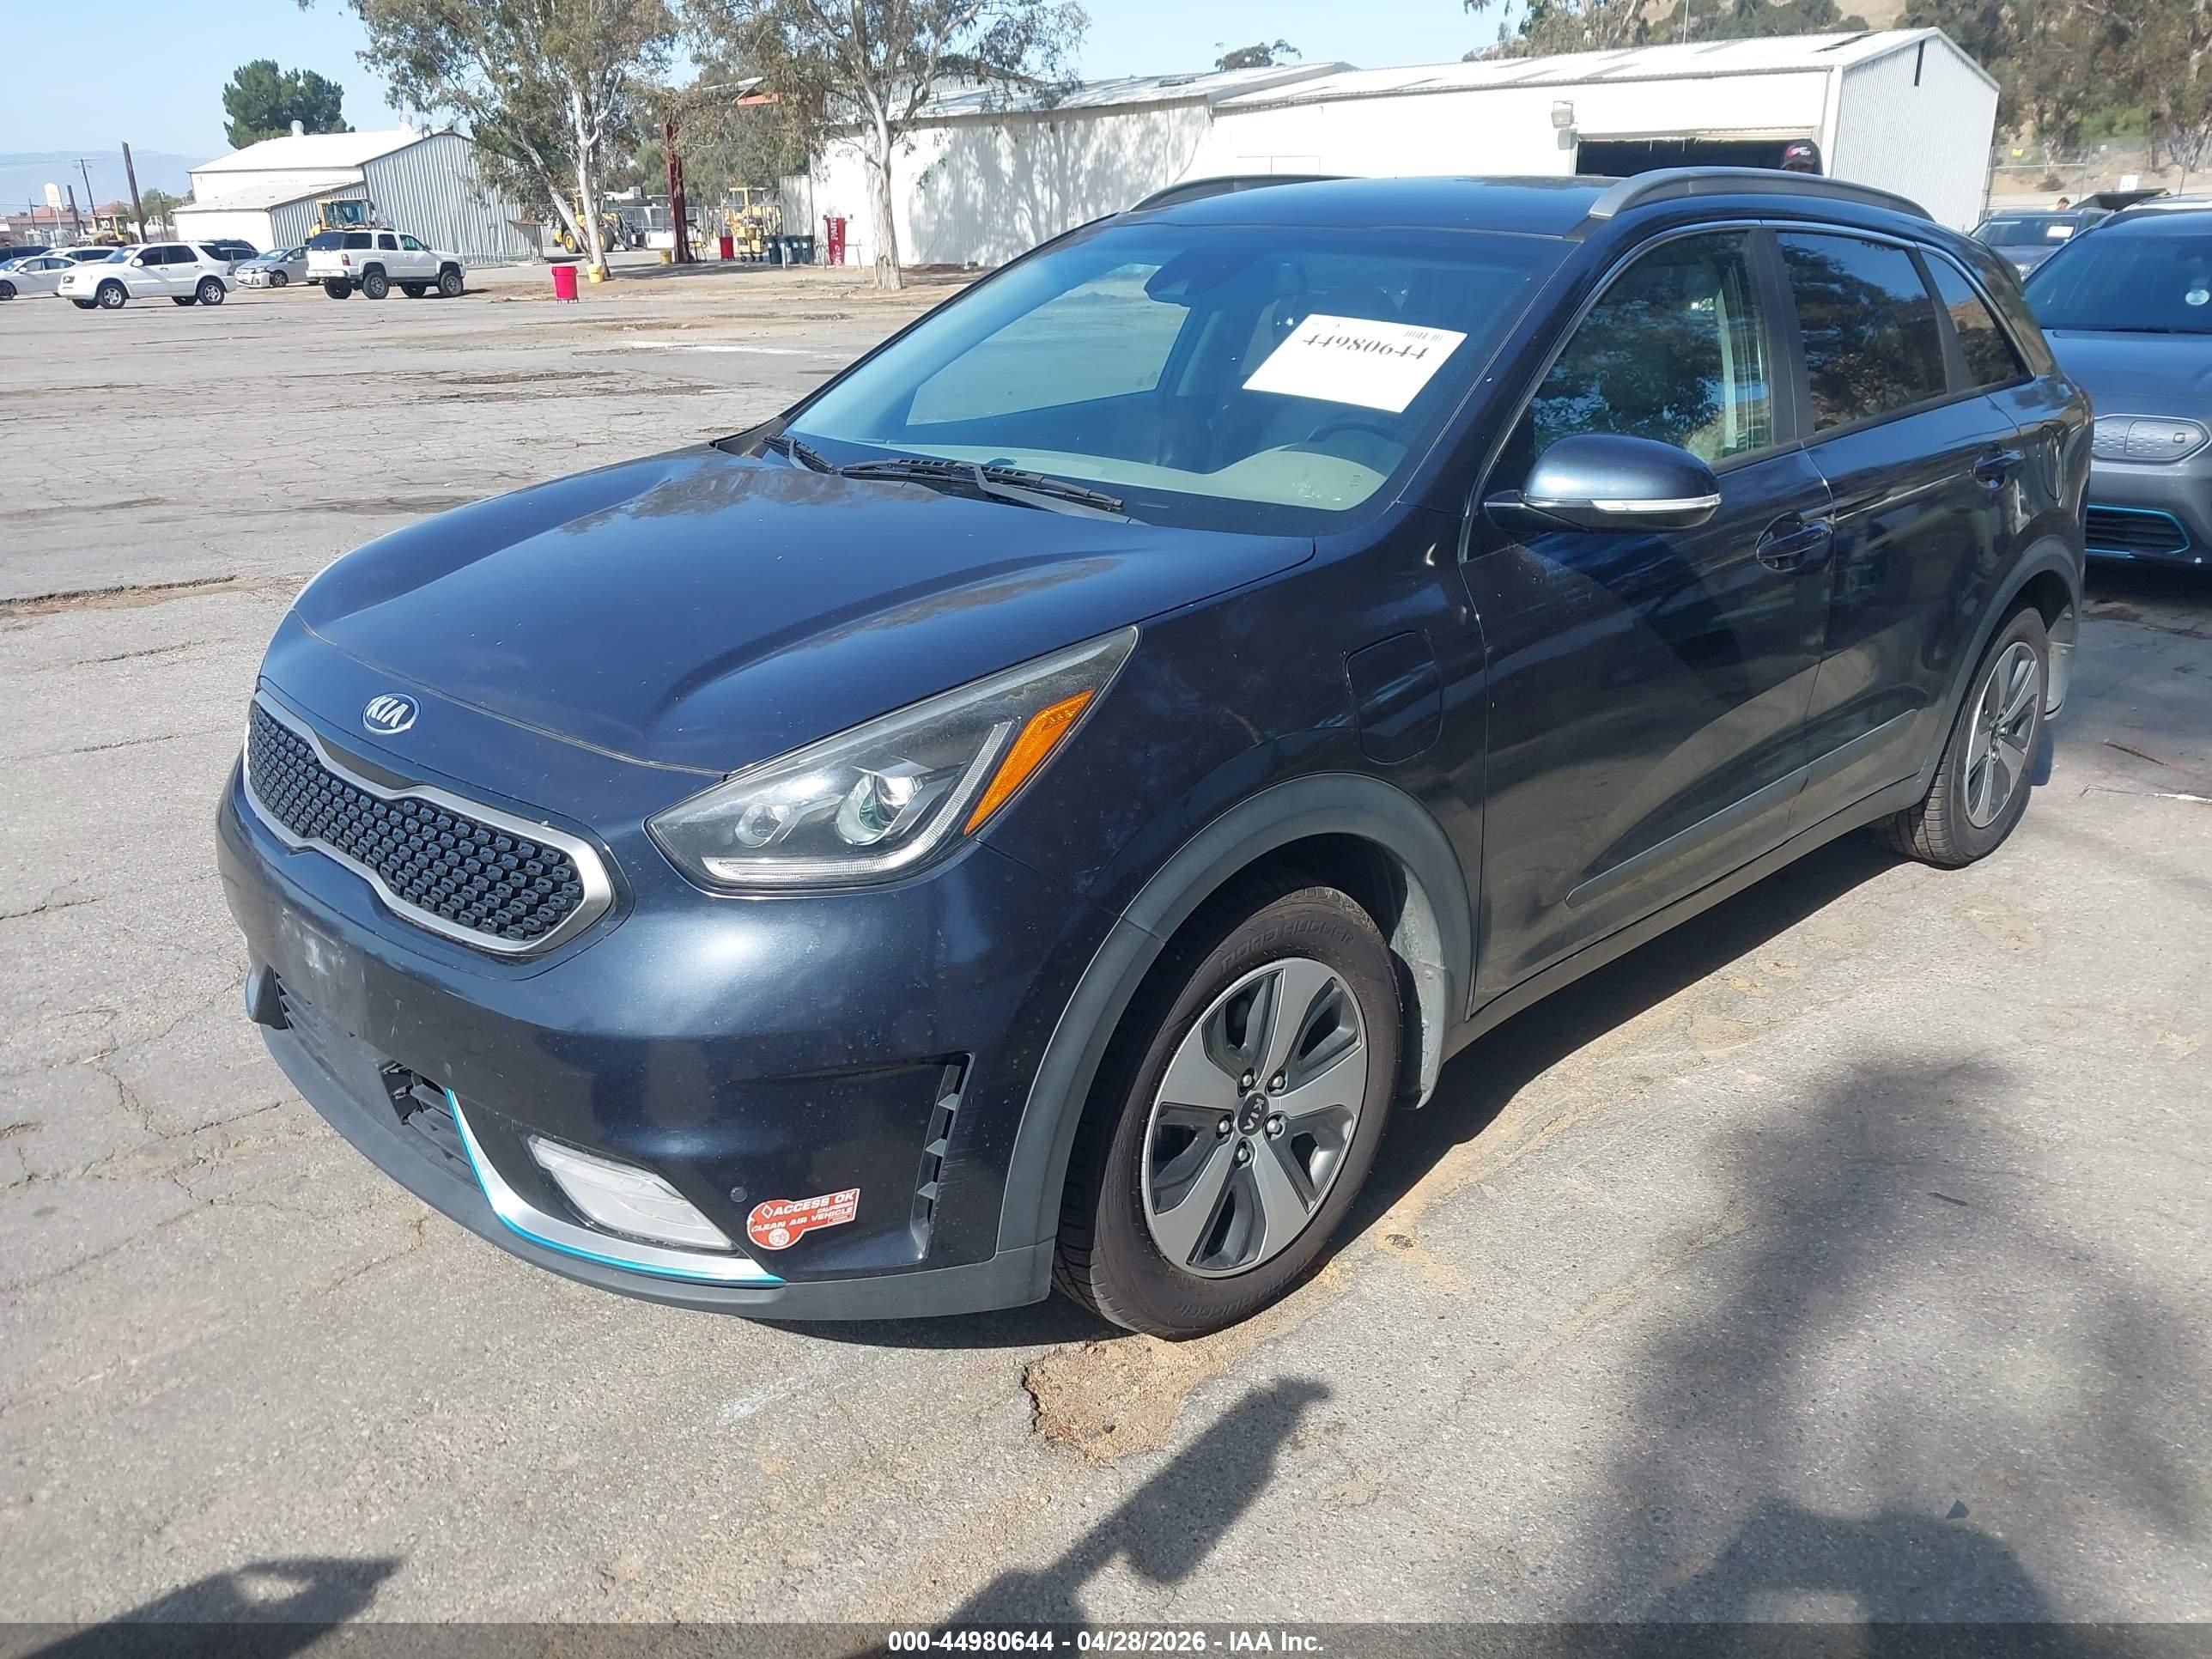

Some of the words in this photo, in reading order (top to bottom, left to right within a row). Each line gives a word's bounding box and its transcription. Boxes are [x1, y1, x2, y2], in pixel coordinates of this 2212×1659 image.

[1303, 333, 1429, 359] 44980644
[366, 696, 410, 728] KIA
[1243, 1097, 1265, 1130] KIA
[773, 1197, 830, 1216] ACCESS
[835, 1192, 855, 1204] OK
[751, 1221, 787, 1232] CLEAN
[789, 1217, 807, 1226] AIR
[811, 1206, 853, 1221] VEHICLE
